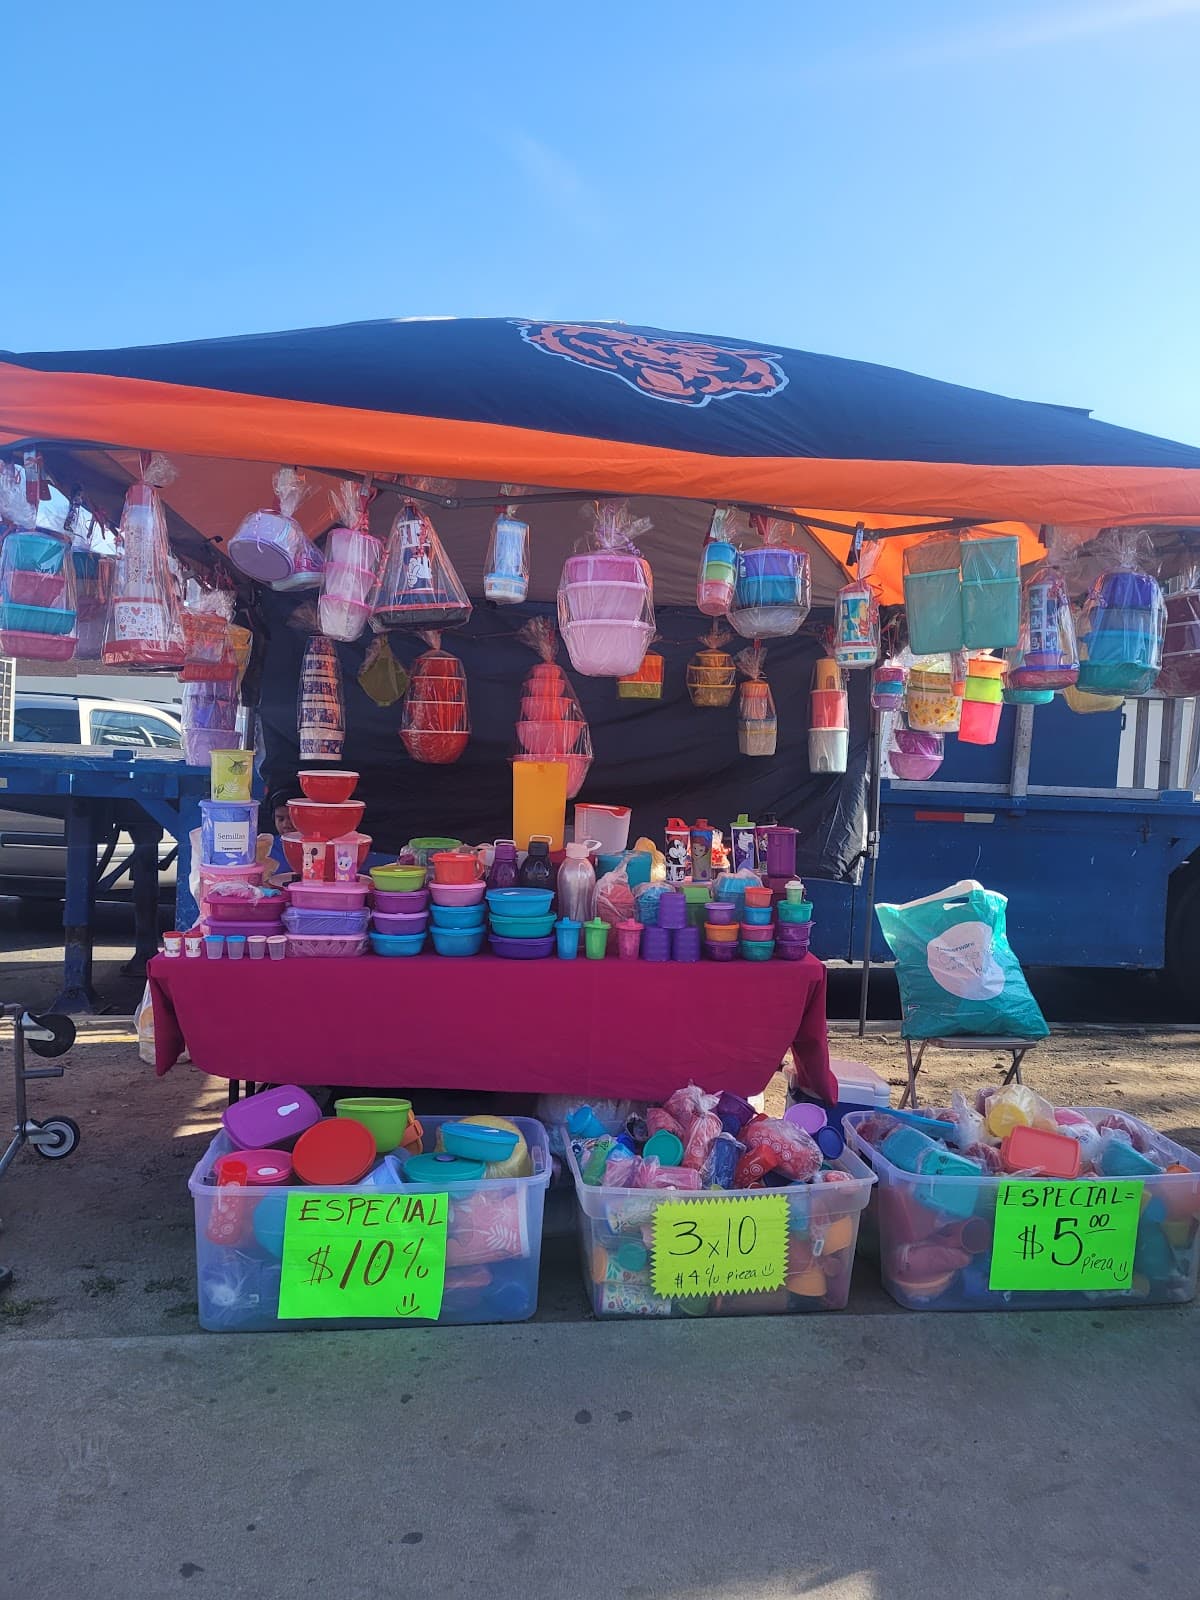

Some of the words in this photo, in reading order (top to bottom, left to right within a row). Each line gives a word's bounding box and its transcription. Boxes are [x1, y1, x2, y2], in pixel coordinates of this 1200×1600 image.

[217, 832, 245, 840] Semillas
[297, 1196, 444, 1226] ESPECIAL
[1081, 1252, 1114, 1275] pieza
[726, 1269, 757, 1284] pieza
